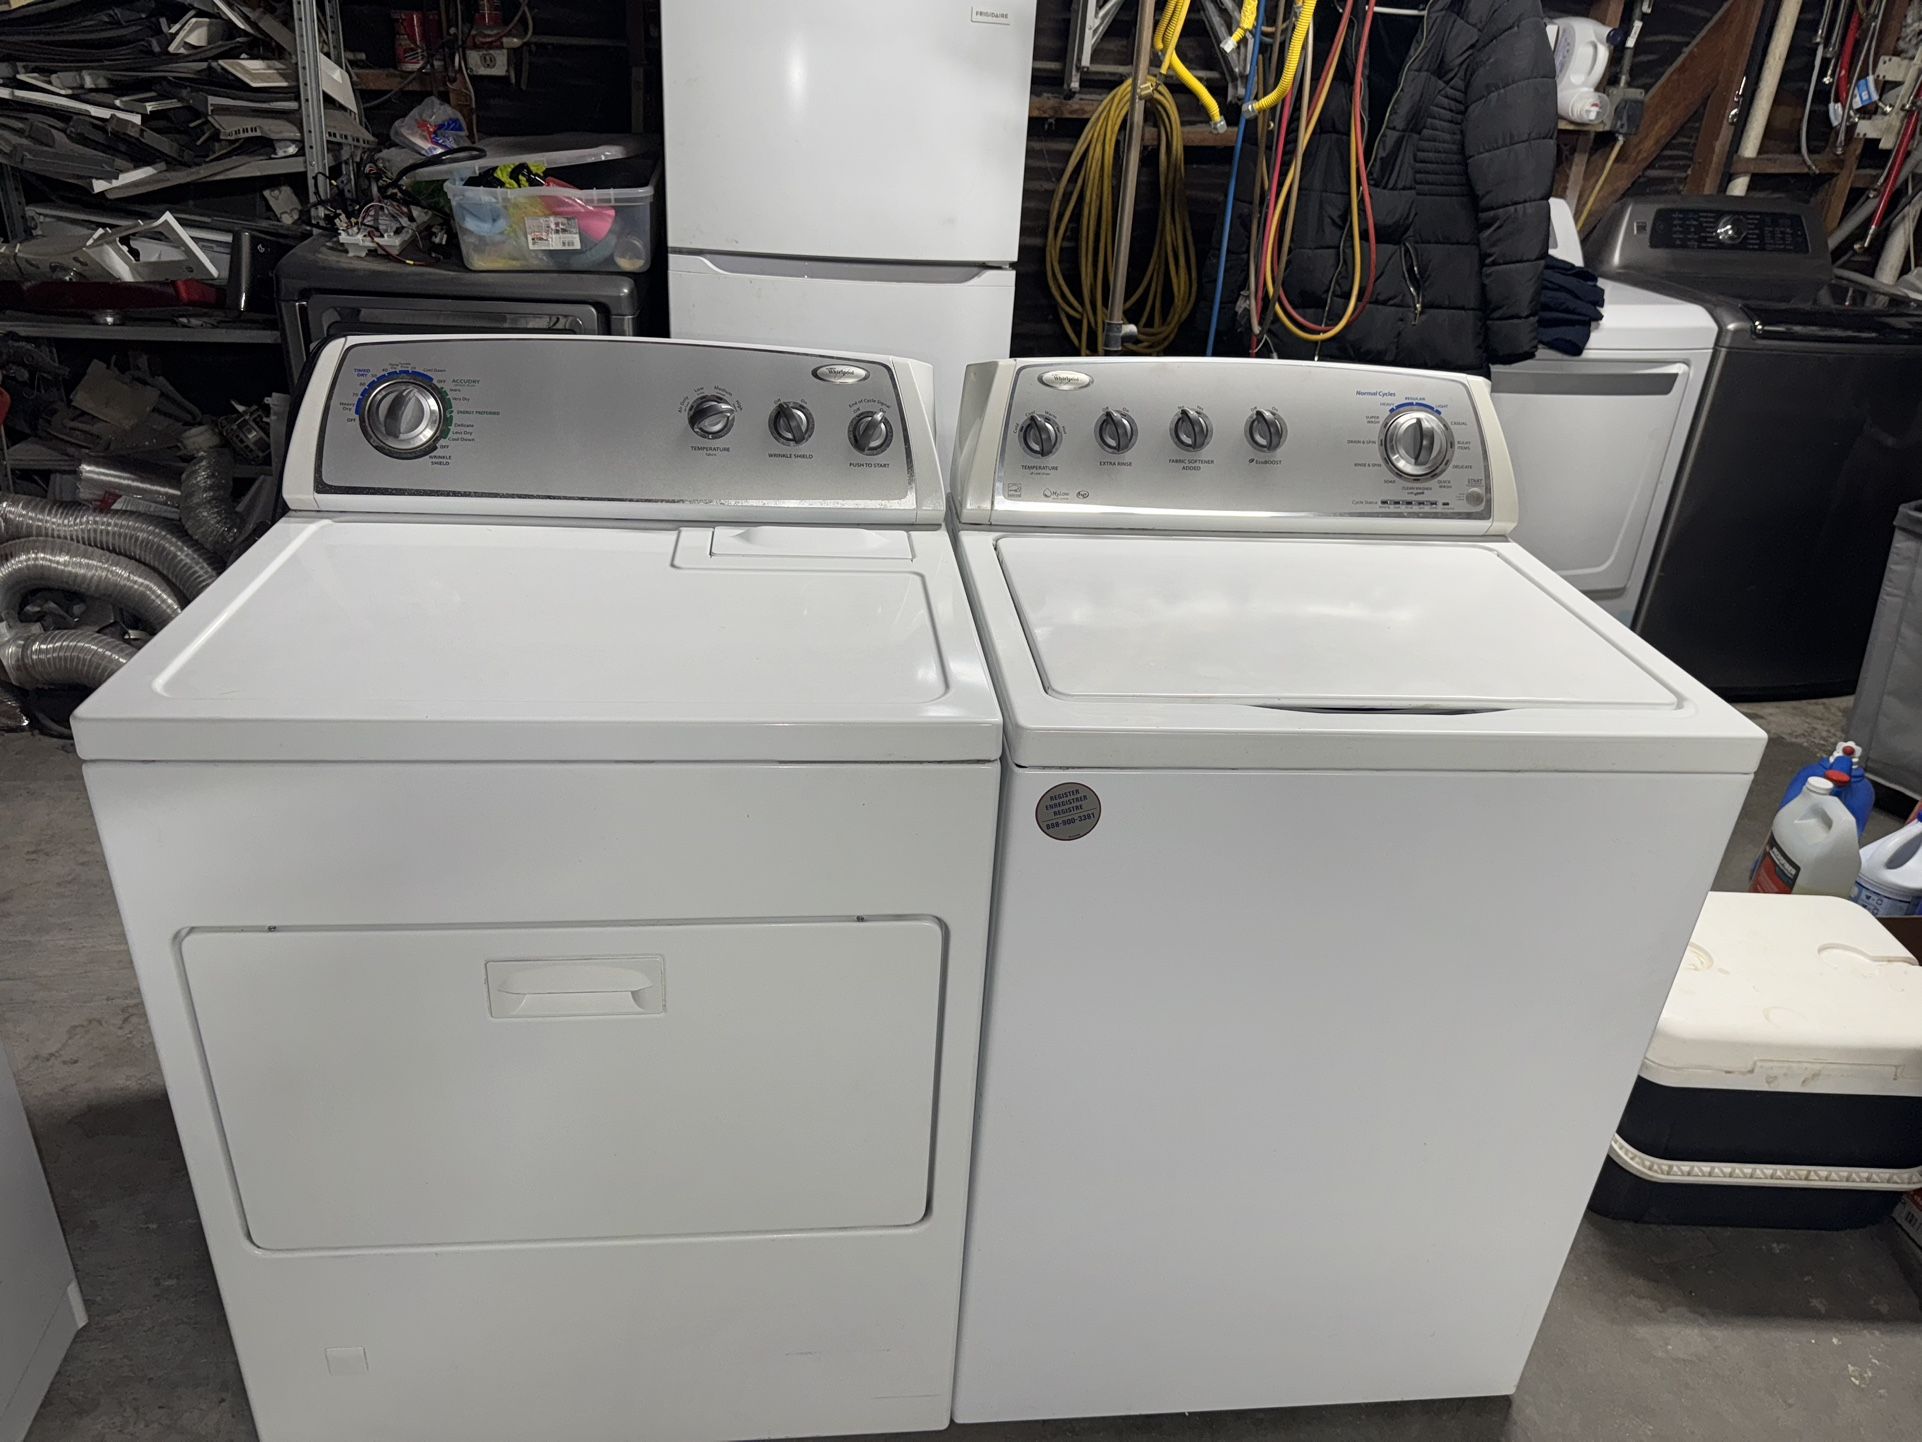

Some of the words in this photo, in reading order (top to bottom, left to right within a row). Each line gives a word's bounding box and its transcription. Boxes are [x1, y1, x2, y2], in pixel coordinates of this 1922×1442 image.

[976, 10, 1008, 19] FRIGIDAIRE
[1050, 788, 1080, 801] REGISTER
[1045, 795, 1088, 811] ENREGISTRER
[1053, 805, 1083, 816] REGISTRE
